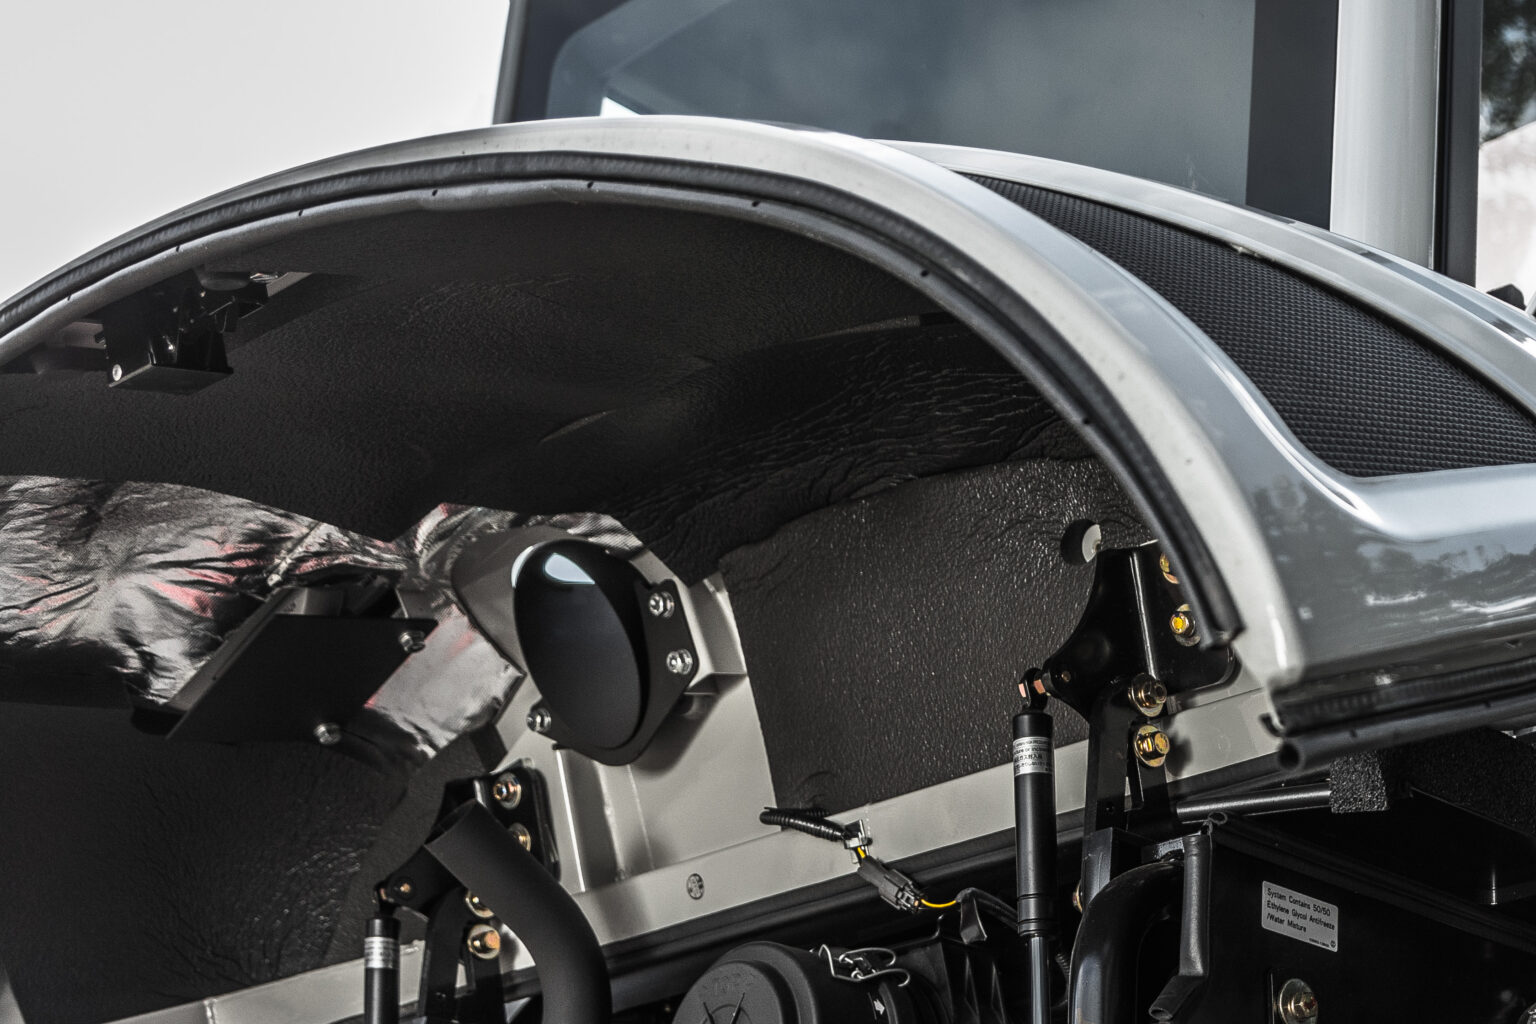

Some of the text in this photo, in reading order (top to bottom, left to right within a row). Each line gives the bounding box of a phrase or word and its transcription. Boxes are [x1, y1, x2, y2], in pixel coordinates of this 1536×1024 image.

[1267, 888, 1331, 917] System Contains 50/50
[1267, 900, 1335, 931] Ethylene Glycol Antifreeze
[1267, 913, 1307, 933] /Water Mixture
